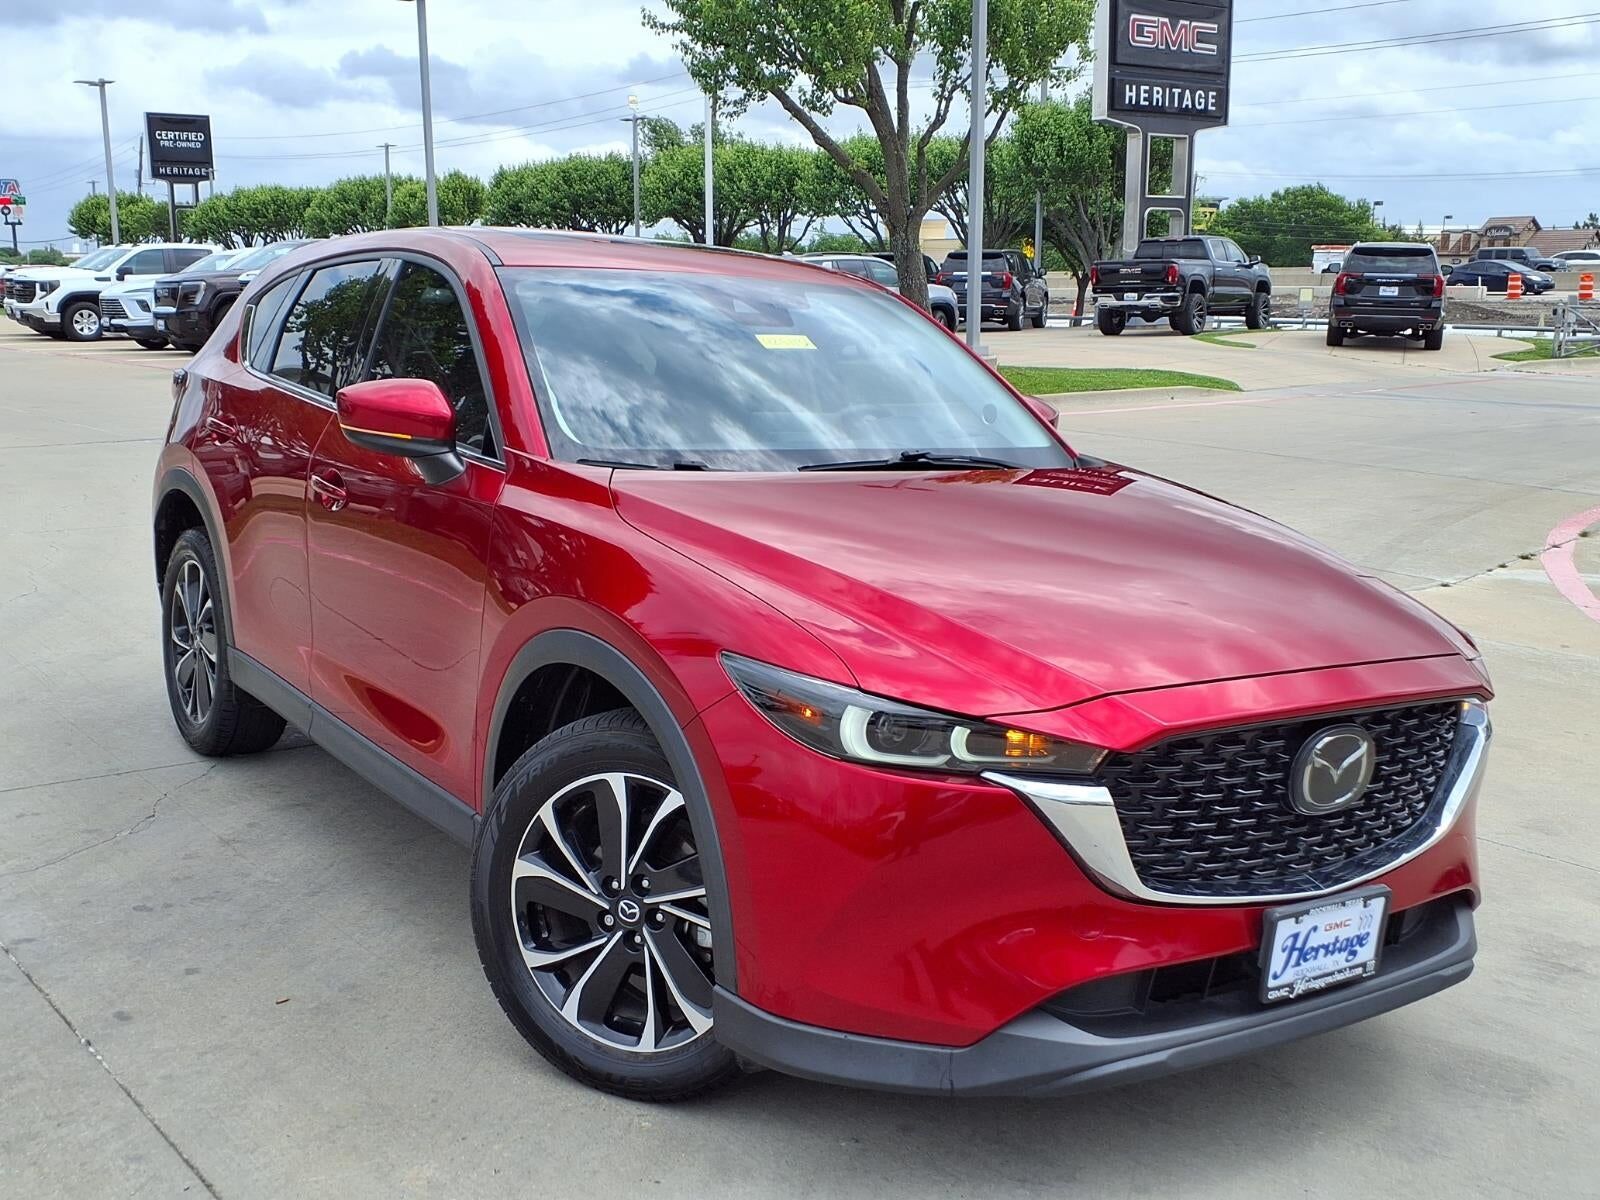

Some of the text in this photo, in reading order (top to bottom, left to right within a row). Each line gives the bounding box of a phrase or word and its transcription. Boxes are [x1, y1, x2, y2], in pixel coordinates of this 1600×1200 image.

[1129, 13, 1218, 55] GMC
[1125, 84, 1217, 111] HERITAGE
[155, 130, 205, 141] CERTIFIED
[160, 140, 202, 148] PRE-OWNED
[159, 166, 208, 176] HERITAGE
[1324, 918, 1353, 932] GMC
[1272, 924, 1371, 981] Heritage
